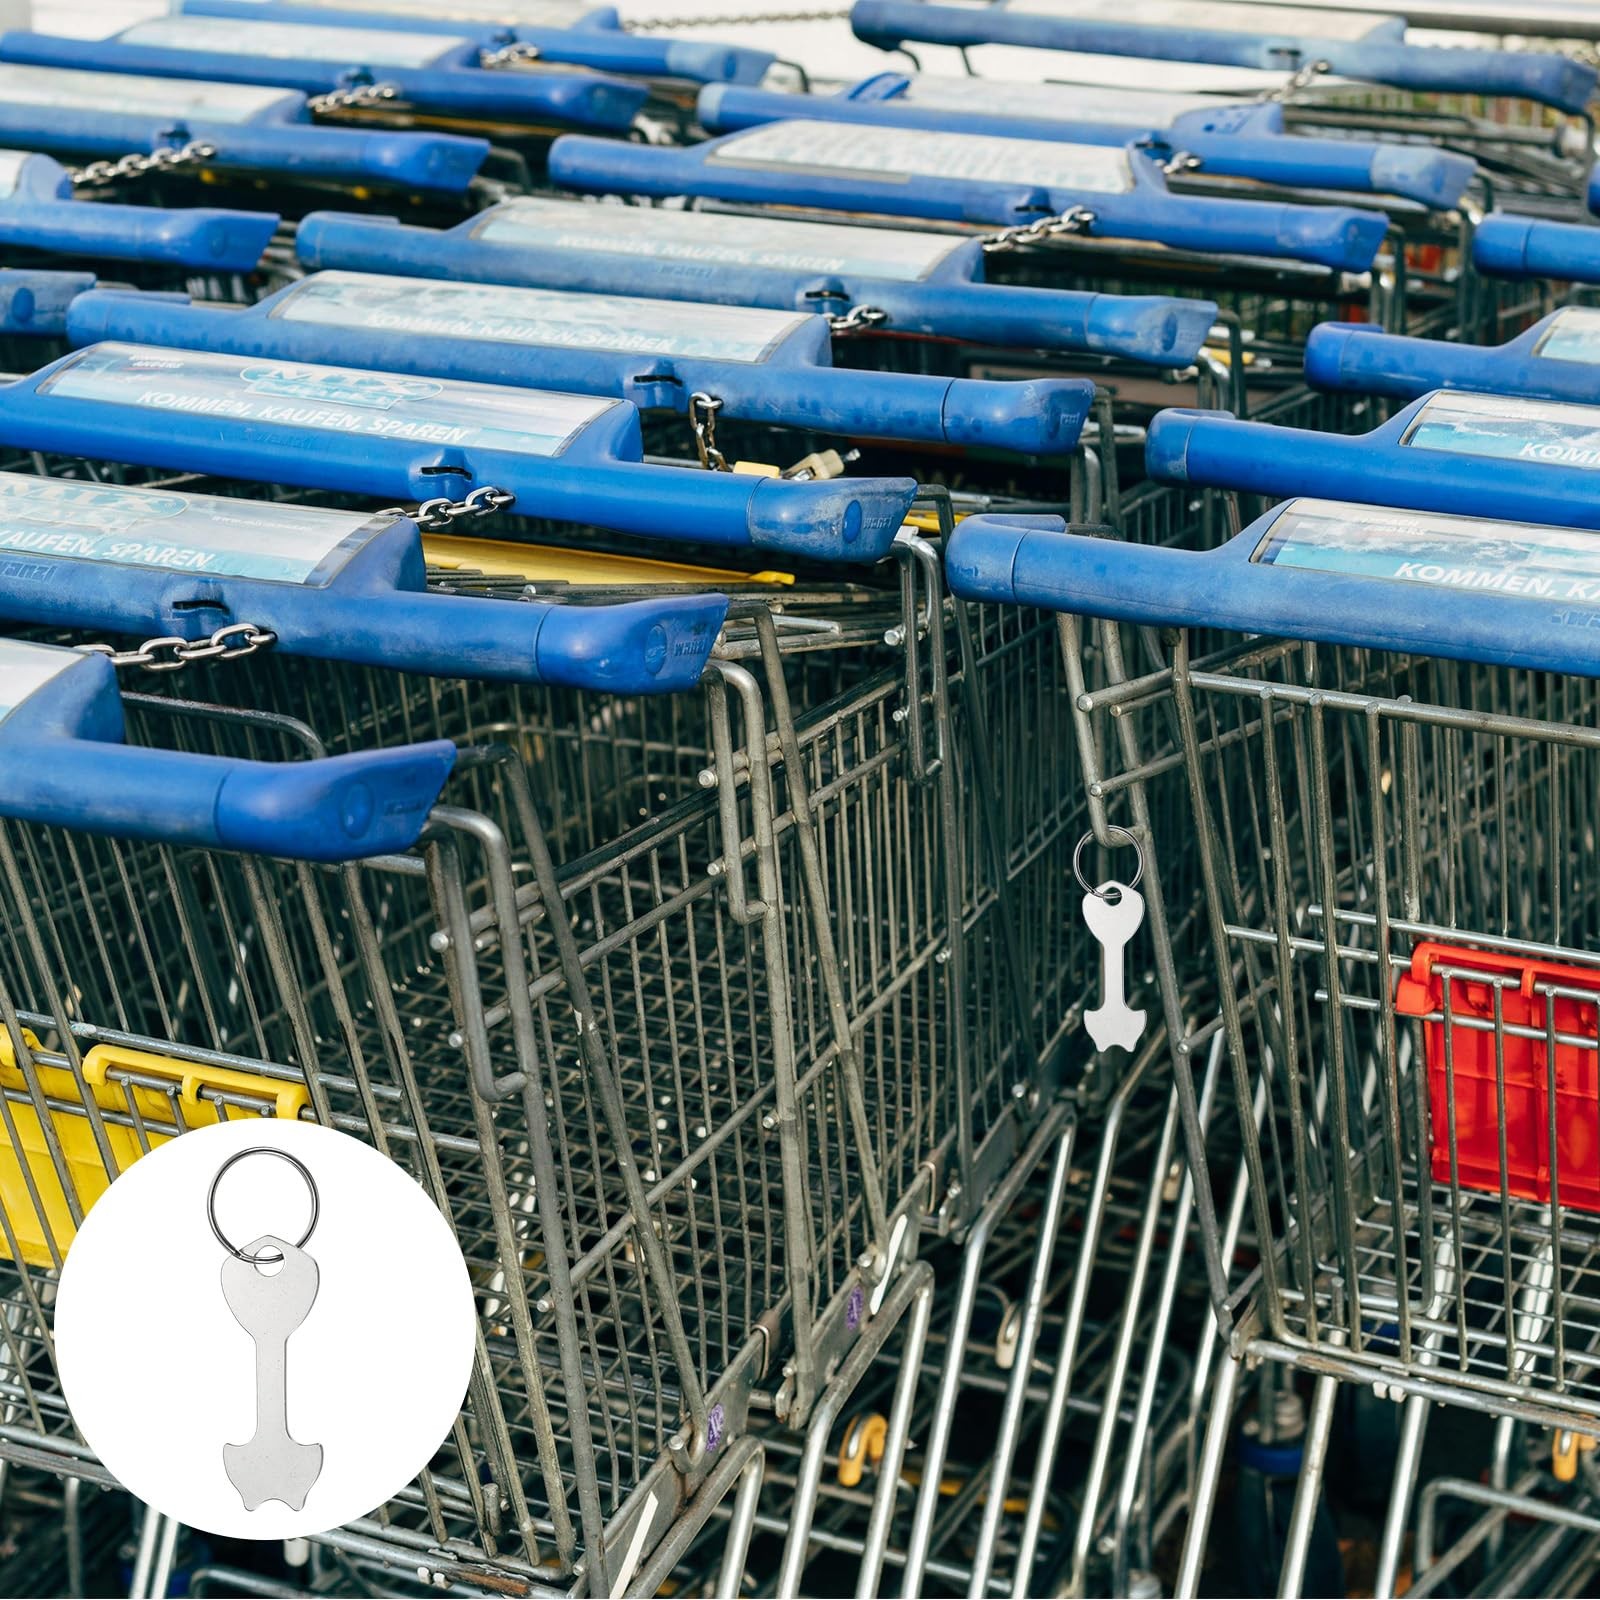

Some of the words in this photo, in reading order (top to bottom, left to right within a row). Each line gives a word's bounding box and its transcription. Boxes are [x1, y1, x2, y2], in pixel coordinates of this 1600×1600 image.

[136, 391, 252, 417] KOMMEN,
[258, 405, 362, 431] KAUFEN,
[368, 418, 468, 441] SPAREN
[0, 530, 96, 557] AUFEN,
[102, 542, 216, 568] SPAREN
[1394, 562, 1557, 597] KOMMEN,
